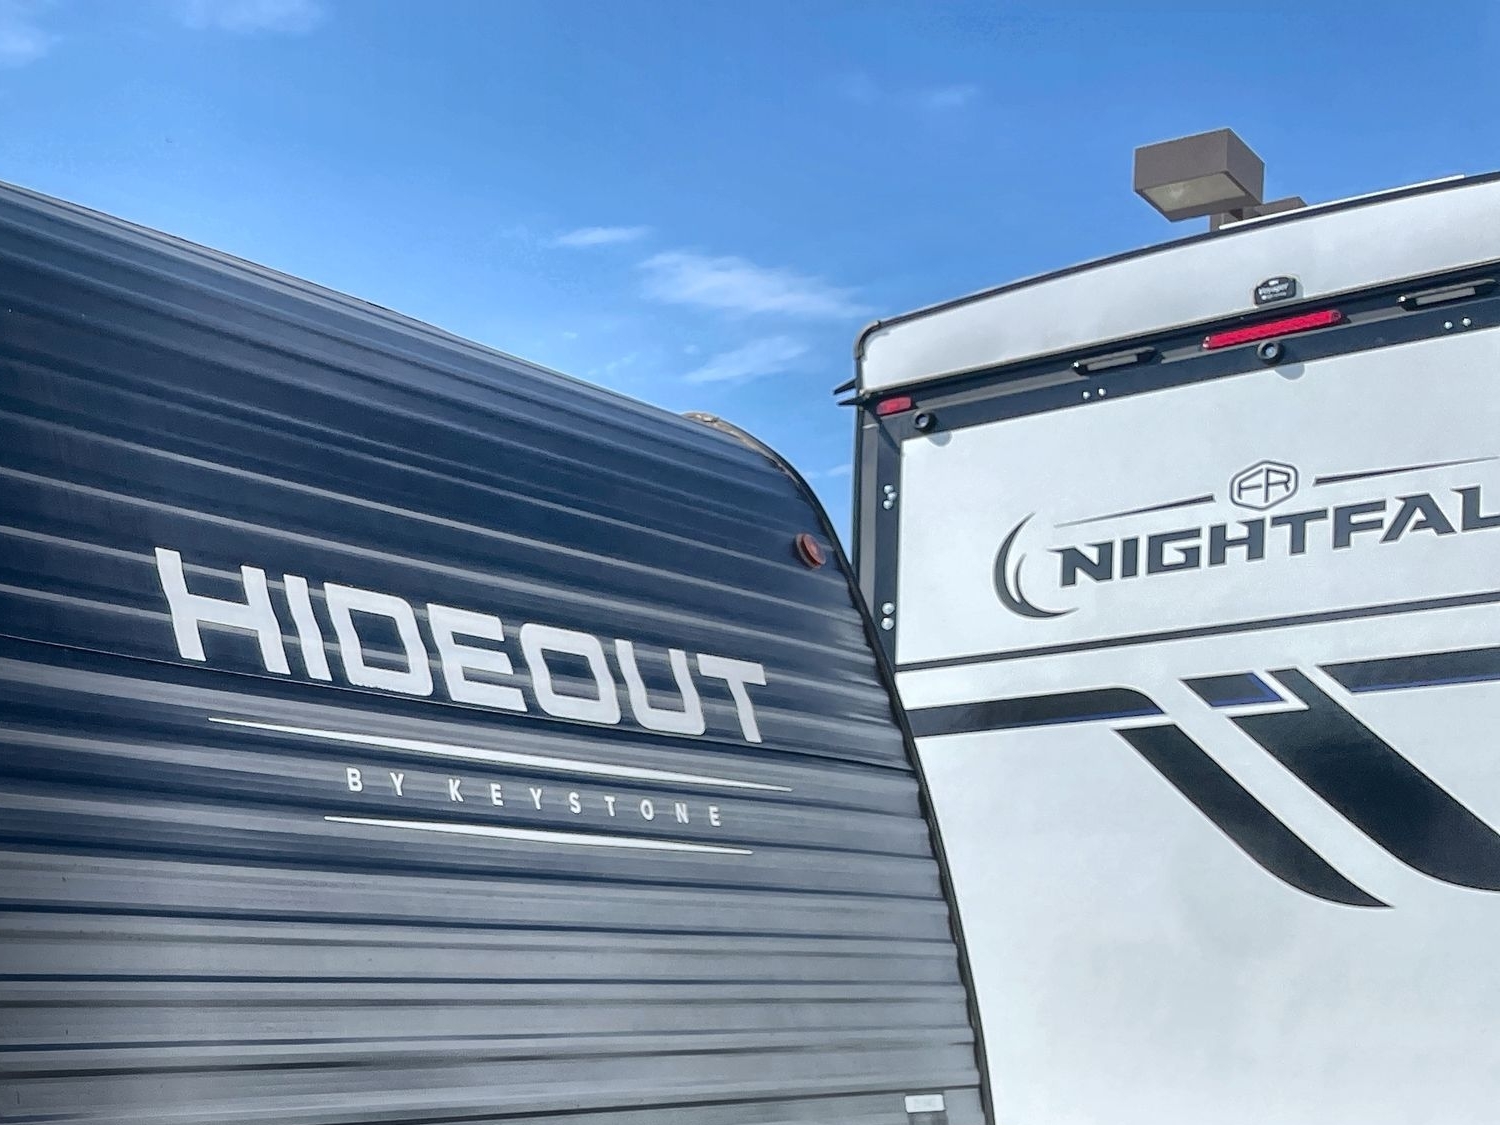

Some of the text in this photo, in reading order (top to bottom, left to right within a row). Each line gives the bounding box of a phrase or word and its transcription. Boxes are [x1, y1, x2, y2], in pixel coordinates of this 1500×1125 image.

[1046, 486, 1500, 588] NIGHTFAL
[154, 546, 767, 744] HIDEOUT
[345, 767, 722, 827] BY KEYSTONE
